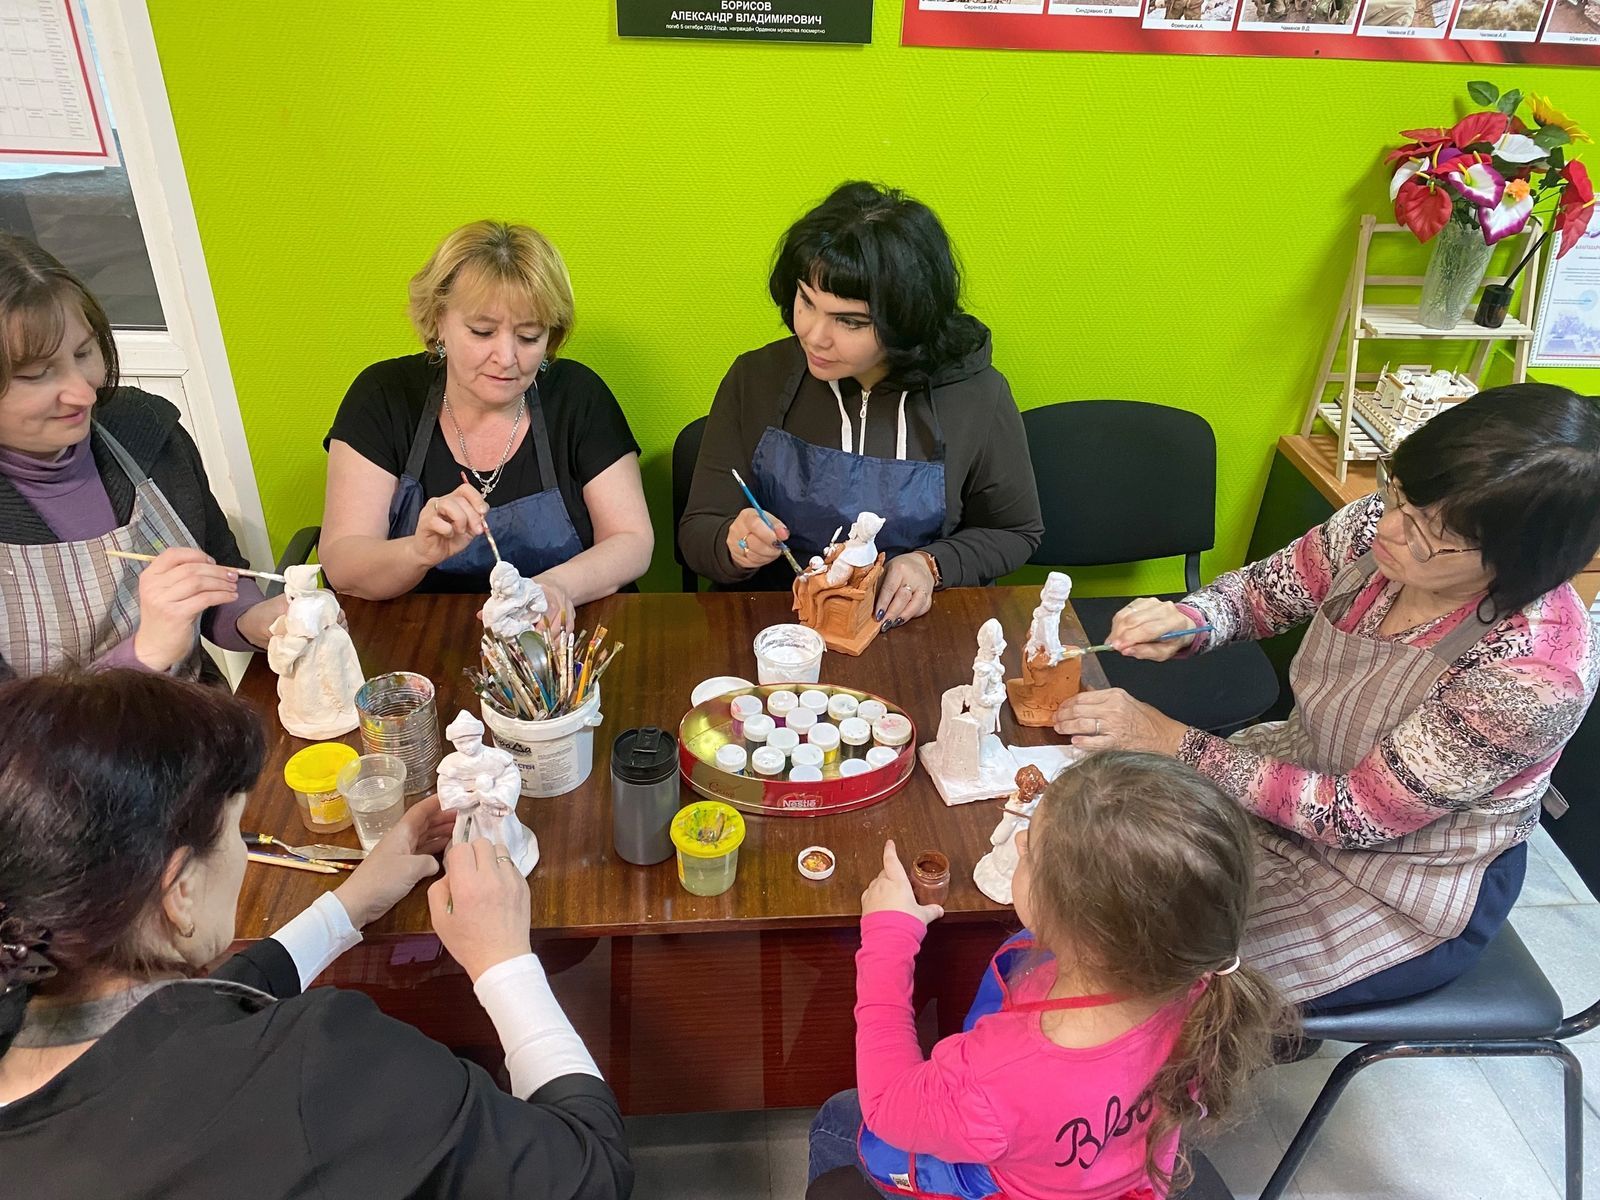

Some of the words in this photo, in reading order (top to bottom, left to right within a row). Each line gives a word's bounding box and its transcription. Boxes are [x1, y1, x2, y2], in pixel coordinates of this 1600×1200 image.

[721, 1, 771, 11] БОРИСОВ
[671, 11, 733, 23] АЛЕКСАНДР
[736, 13, 822, 25] ВЛАДИМИРОВИЧ
